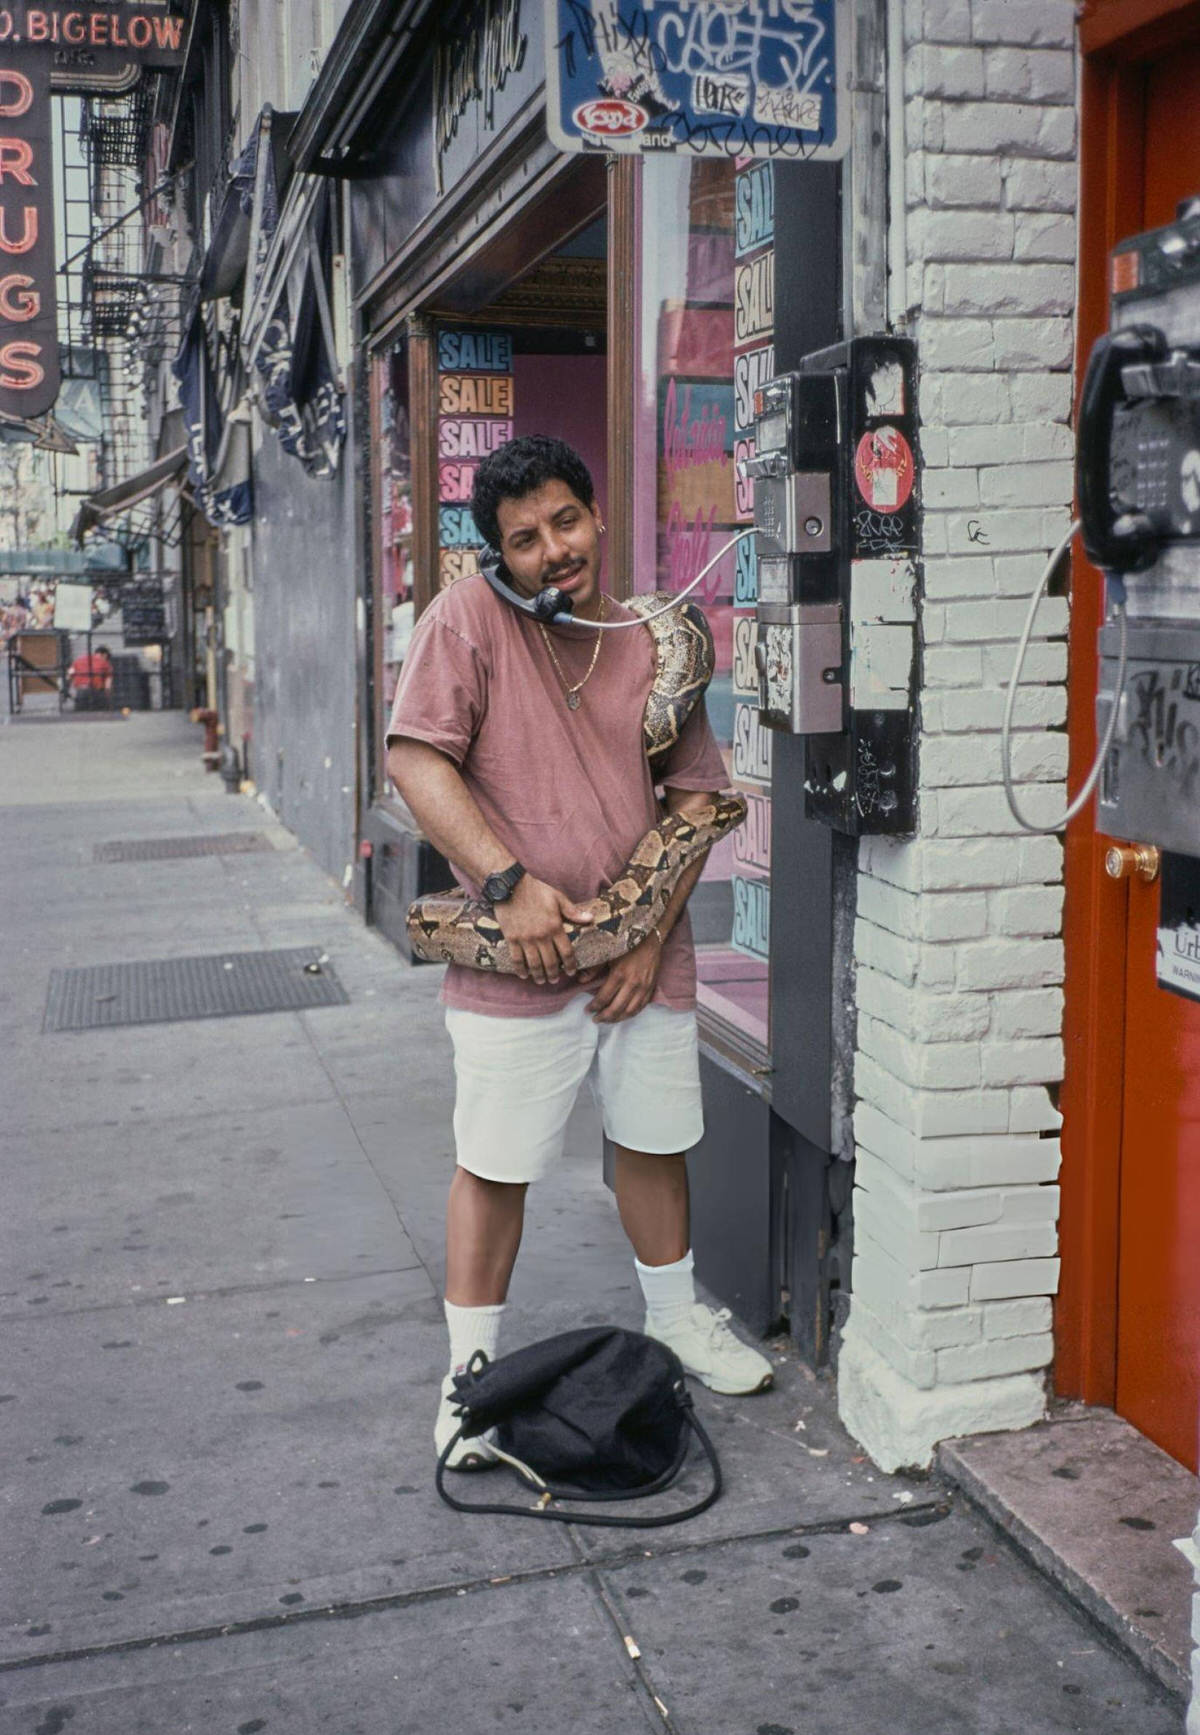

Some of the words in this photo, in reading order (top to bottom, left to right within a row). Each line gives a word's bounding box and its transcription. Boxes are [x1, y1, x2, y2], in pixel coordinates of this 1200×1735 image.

[27, 10, 184, 49] BIGELOW
[0, 69, 45, 390] DRUGS
[737, 162, 774, 250] SAL
[737, 256, 774, 340] SAL
[440, 332, 511, 372] SALE
[440, 375, 511, 416] SALE
[440, 464, 479, 501] SA
[440, 508, 487, 548] SA
[442, 552, 480, 588] SA
[736, 528, 757, 603] SA
[735, 617, 759, 690] SA
[735, 704, 772, 780] SAL
[734, 876, 770, 957] SAL
